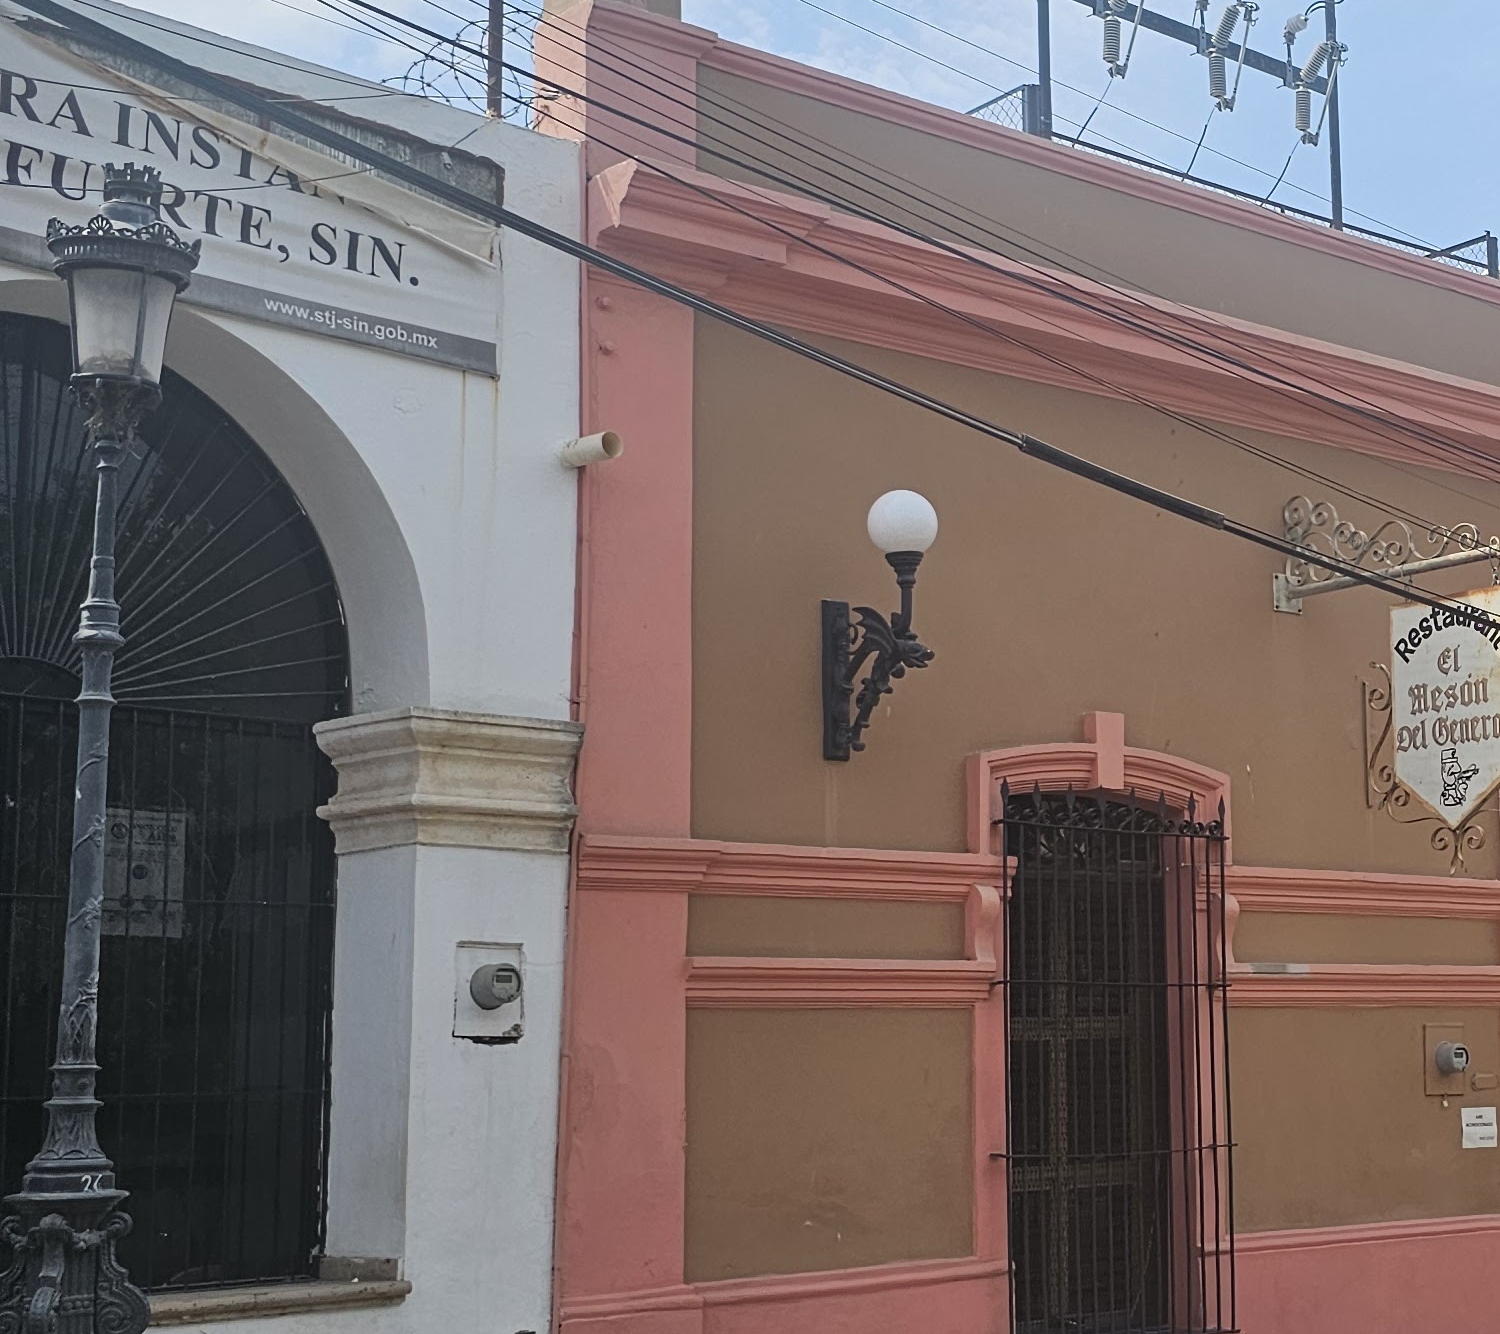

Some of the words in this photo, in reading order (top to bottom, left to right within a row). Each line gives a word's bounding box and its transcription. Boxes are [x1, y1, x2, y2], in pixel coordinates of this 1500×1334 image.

[3, 139, 290, 264] FURTE,
[309, 222, 420, 287] SIN.
[264, 298, 438, 349] www.stj-sin.gob.mx
[1437, 644, 1461, 675] El
[1408, 672, 1489, 716] Mesón
[1397, 718, 1429, 753] Del
